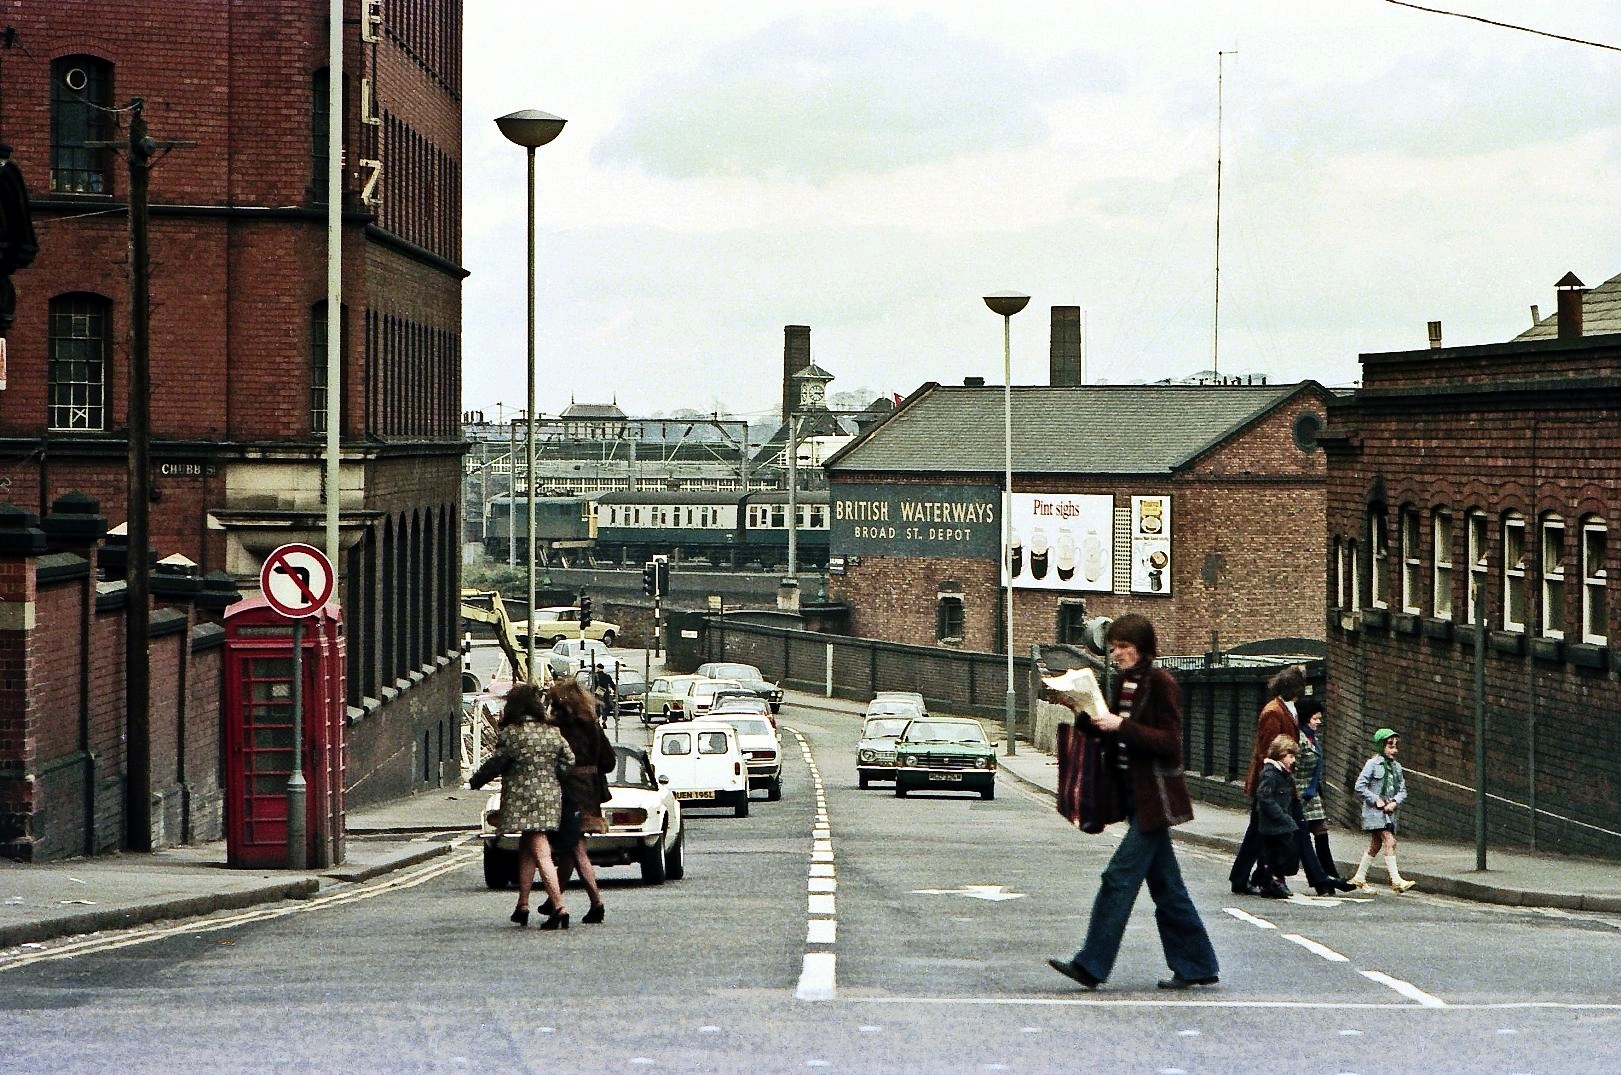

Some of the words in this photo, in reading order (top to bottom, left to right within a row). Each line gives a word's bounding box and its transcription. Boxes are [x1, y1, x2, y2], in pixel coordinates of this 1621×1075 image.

[161, 463, 201, 475] CHUBB
[836, 500, 889, 522] BRITISH
[900, 501, 994, 524] WATERWAYS
[1033, 499, 1054, 516] Pint
[1055, 500, 1080, 520] sighs
[854, 526, 896, 540] BROAD
[929, 528, 971, 542] DEPOT
